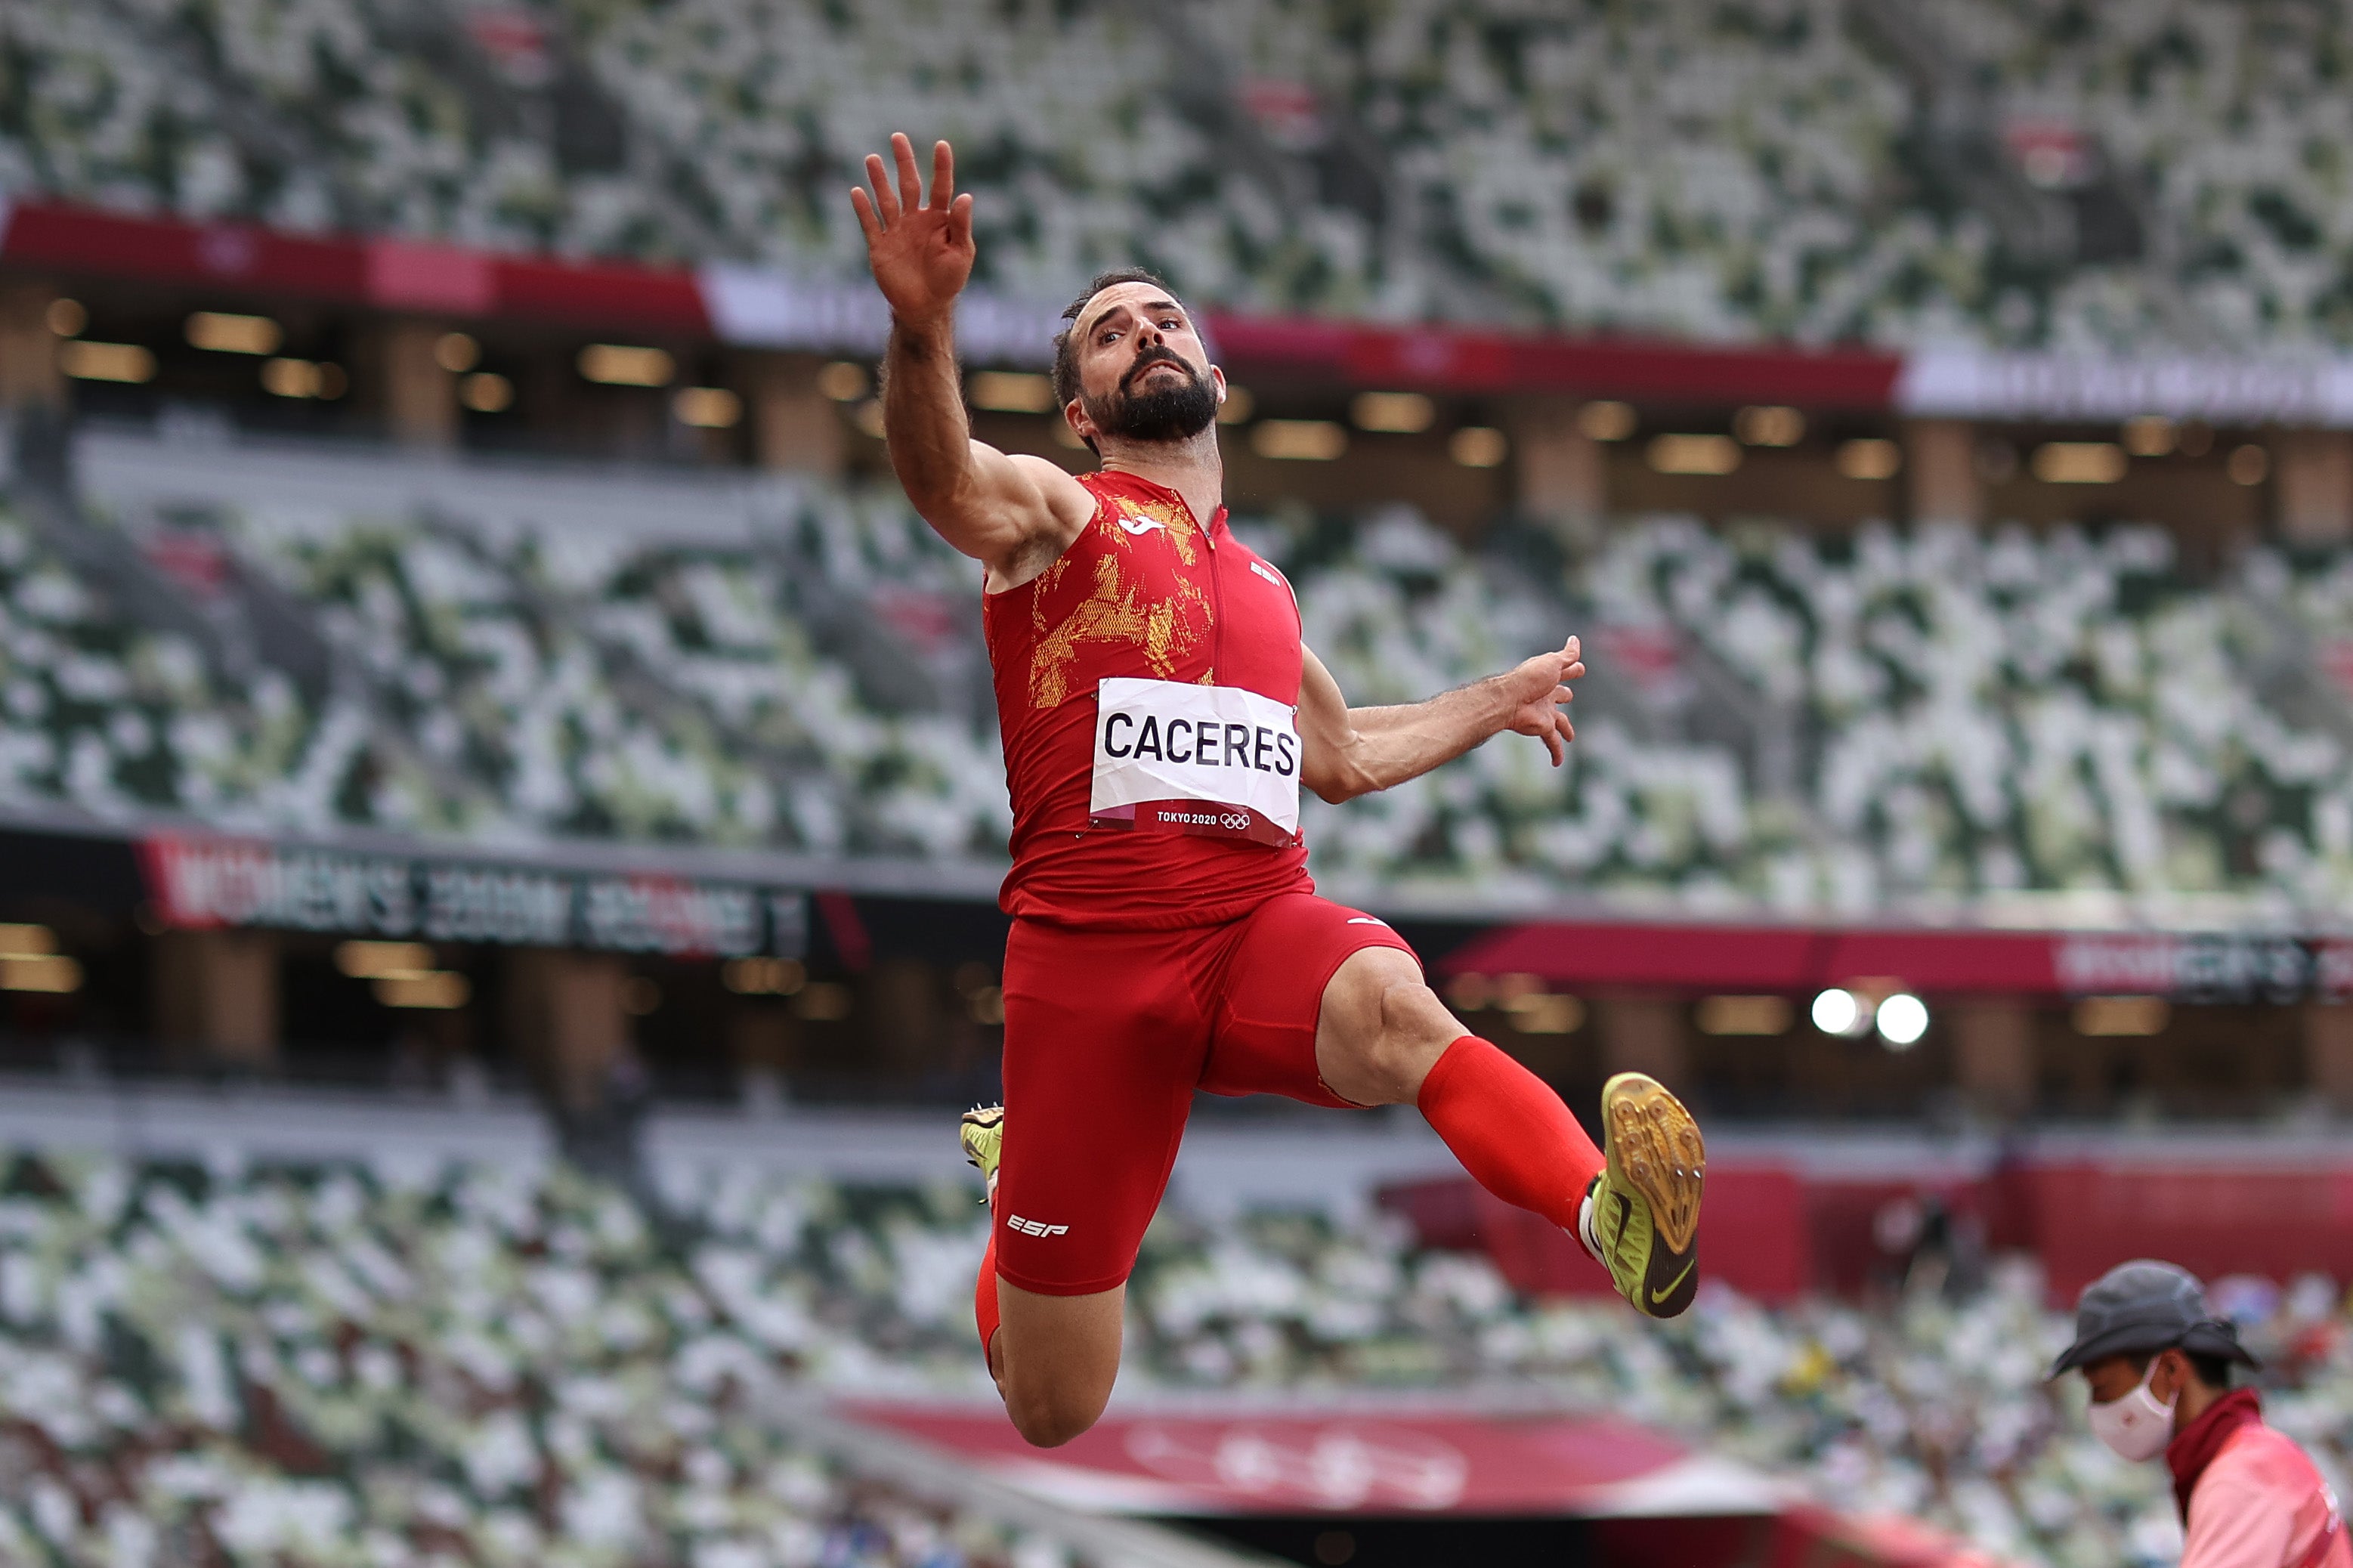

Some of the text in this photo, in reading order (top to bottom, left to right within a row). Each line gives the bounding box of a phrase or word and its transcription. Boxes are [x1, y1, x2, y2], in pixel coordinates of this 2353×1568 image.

[1104, 713, 1294, 776] CACERES
[1158, 812, 1217, 824] TOKYO 2020
[1006, 1214, 1069, 1238] ESP
